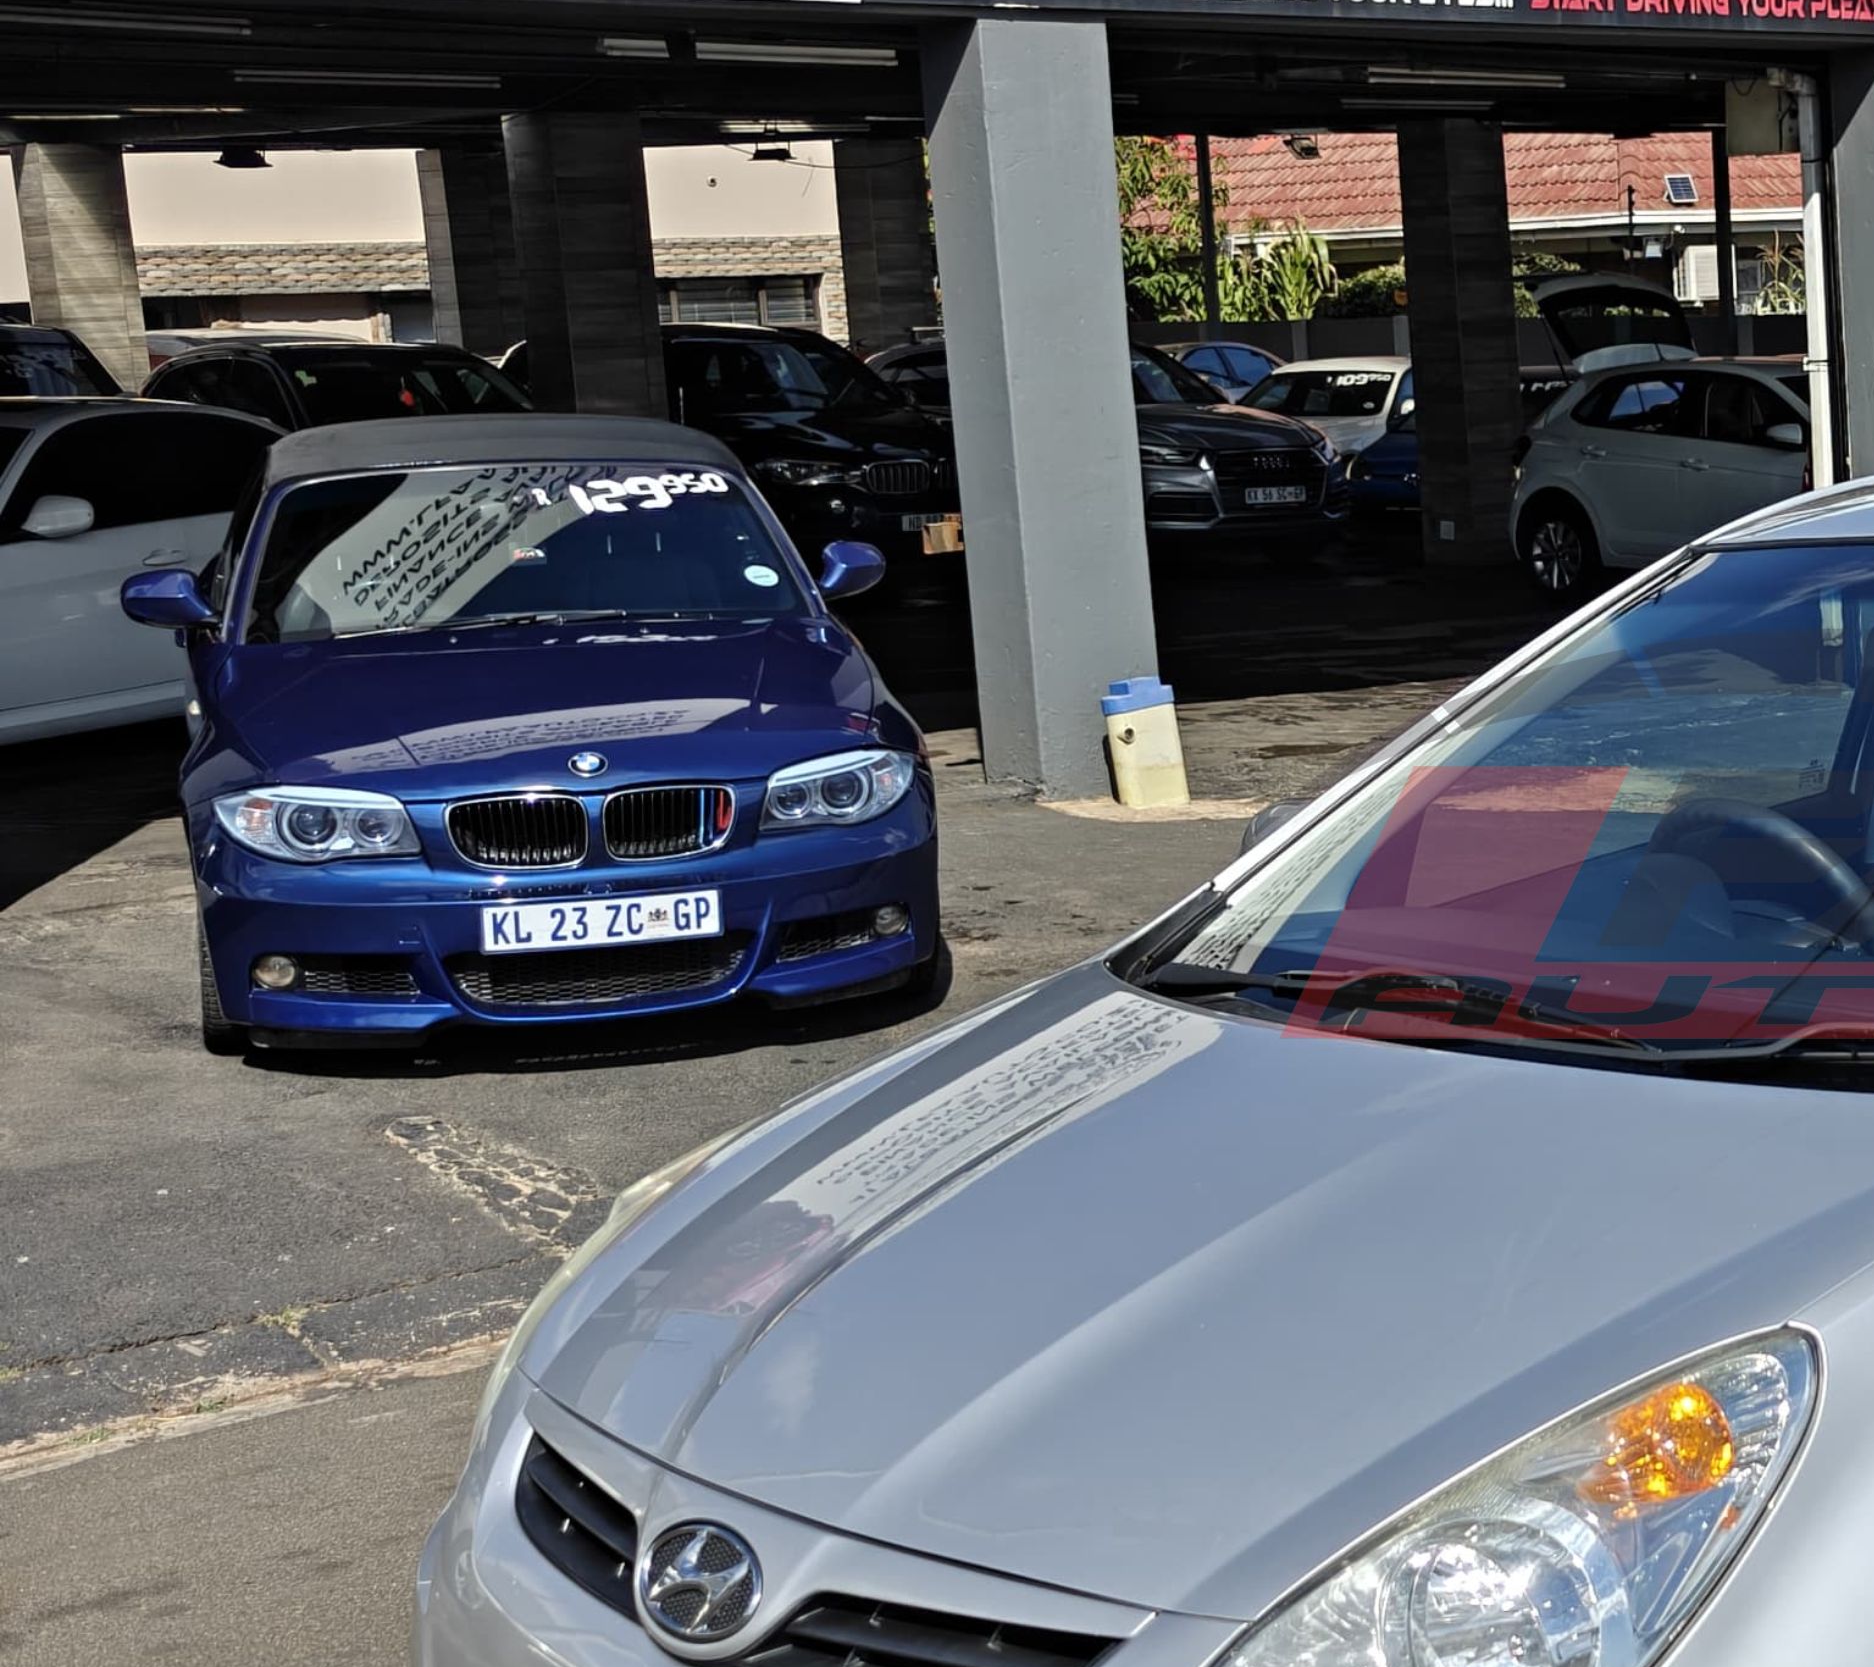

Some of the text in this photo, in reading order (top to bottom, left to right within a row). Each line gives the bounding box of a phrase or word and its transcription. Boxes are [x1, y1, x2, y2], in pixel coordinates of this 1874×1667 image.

[492, 897, 710, 945] KL 23 ZC GP
